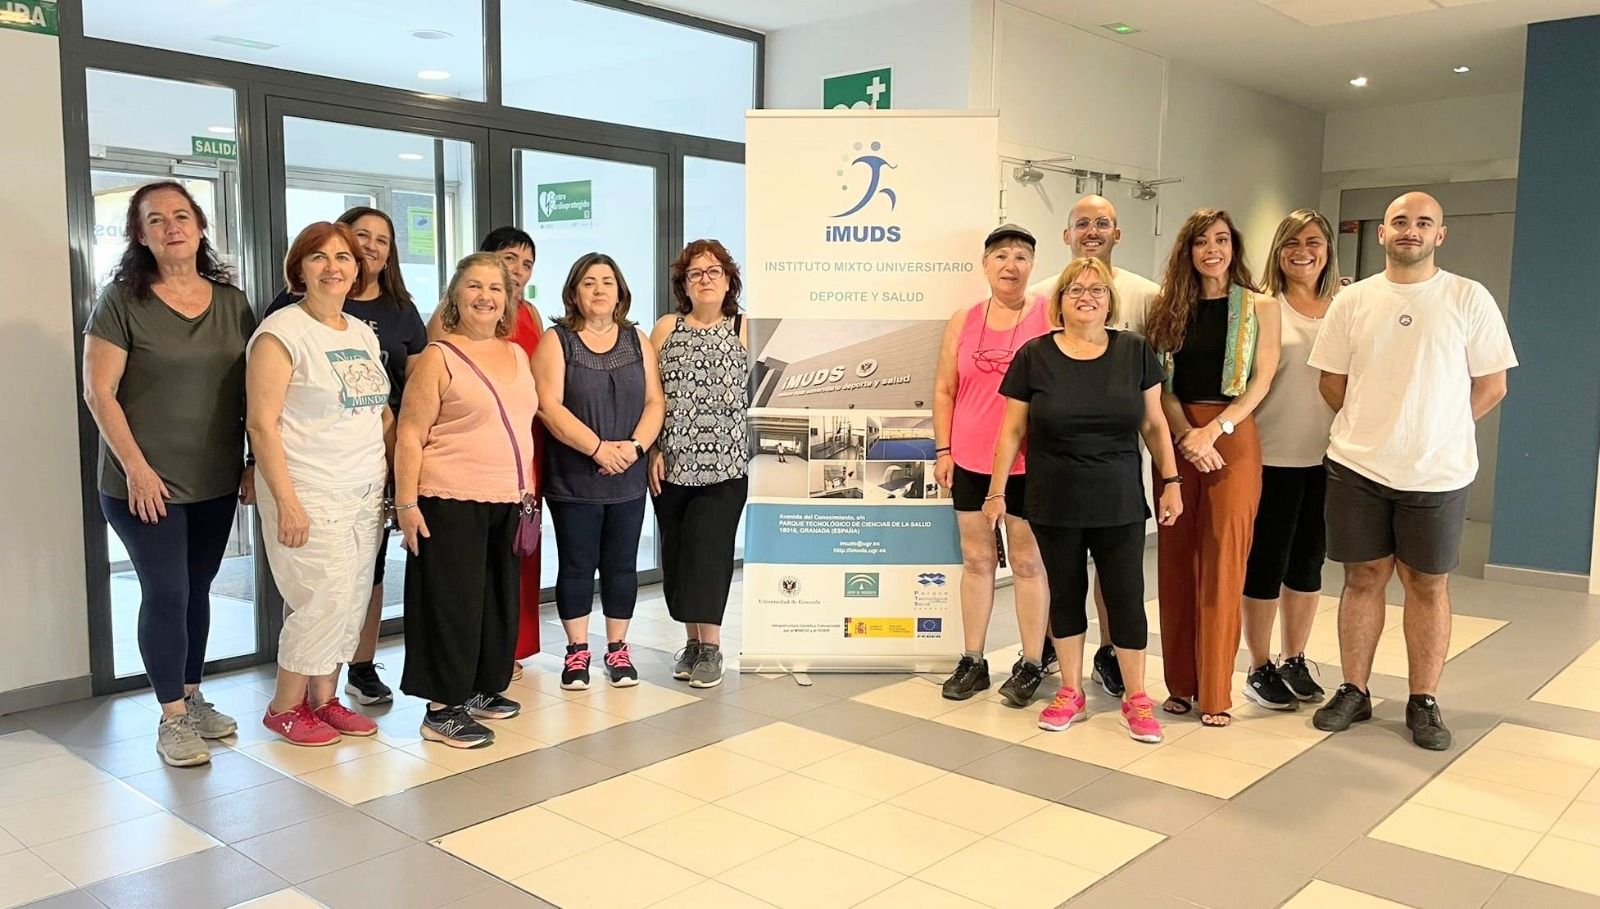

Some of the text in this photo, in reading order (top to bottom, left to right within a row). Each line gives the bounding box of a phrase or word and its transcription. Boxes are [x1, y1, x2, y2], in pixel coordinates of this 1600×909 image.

[825, 225, 901, 242] iMUDS
[764, 261, 973, 273] INSTITUTO MIXTO UNIVERSITARIO
[809, 291, 924, 302] DEPORTE Y SALUD
